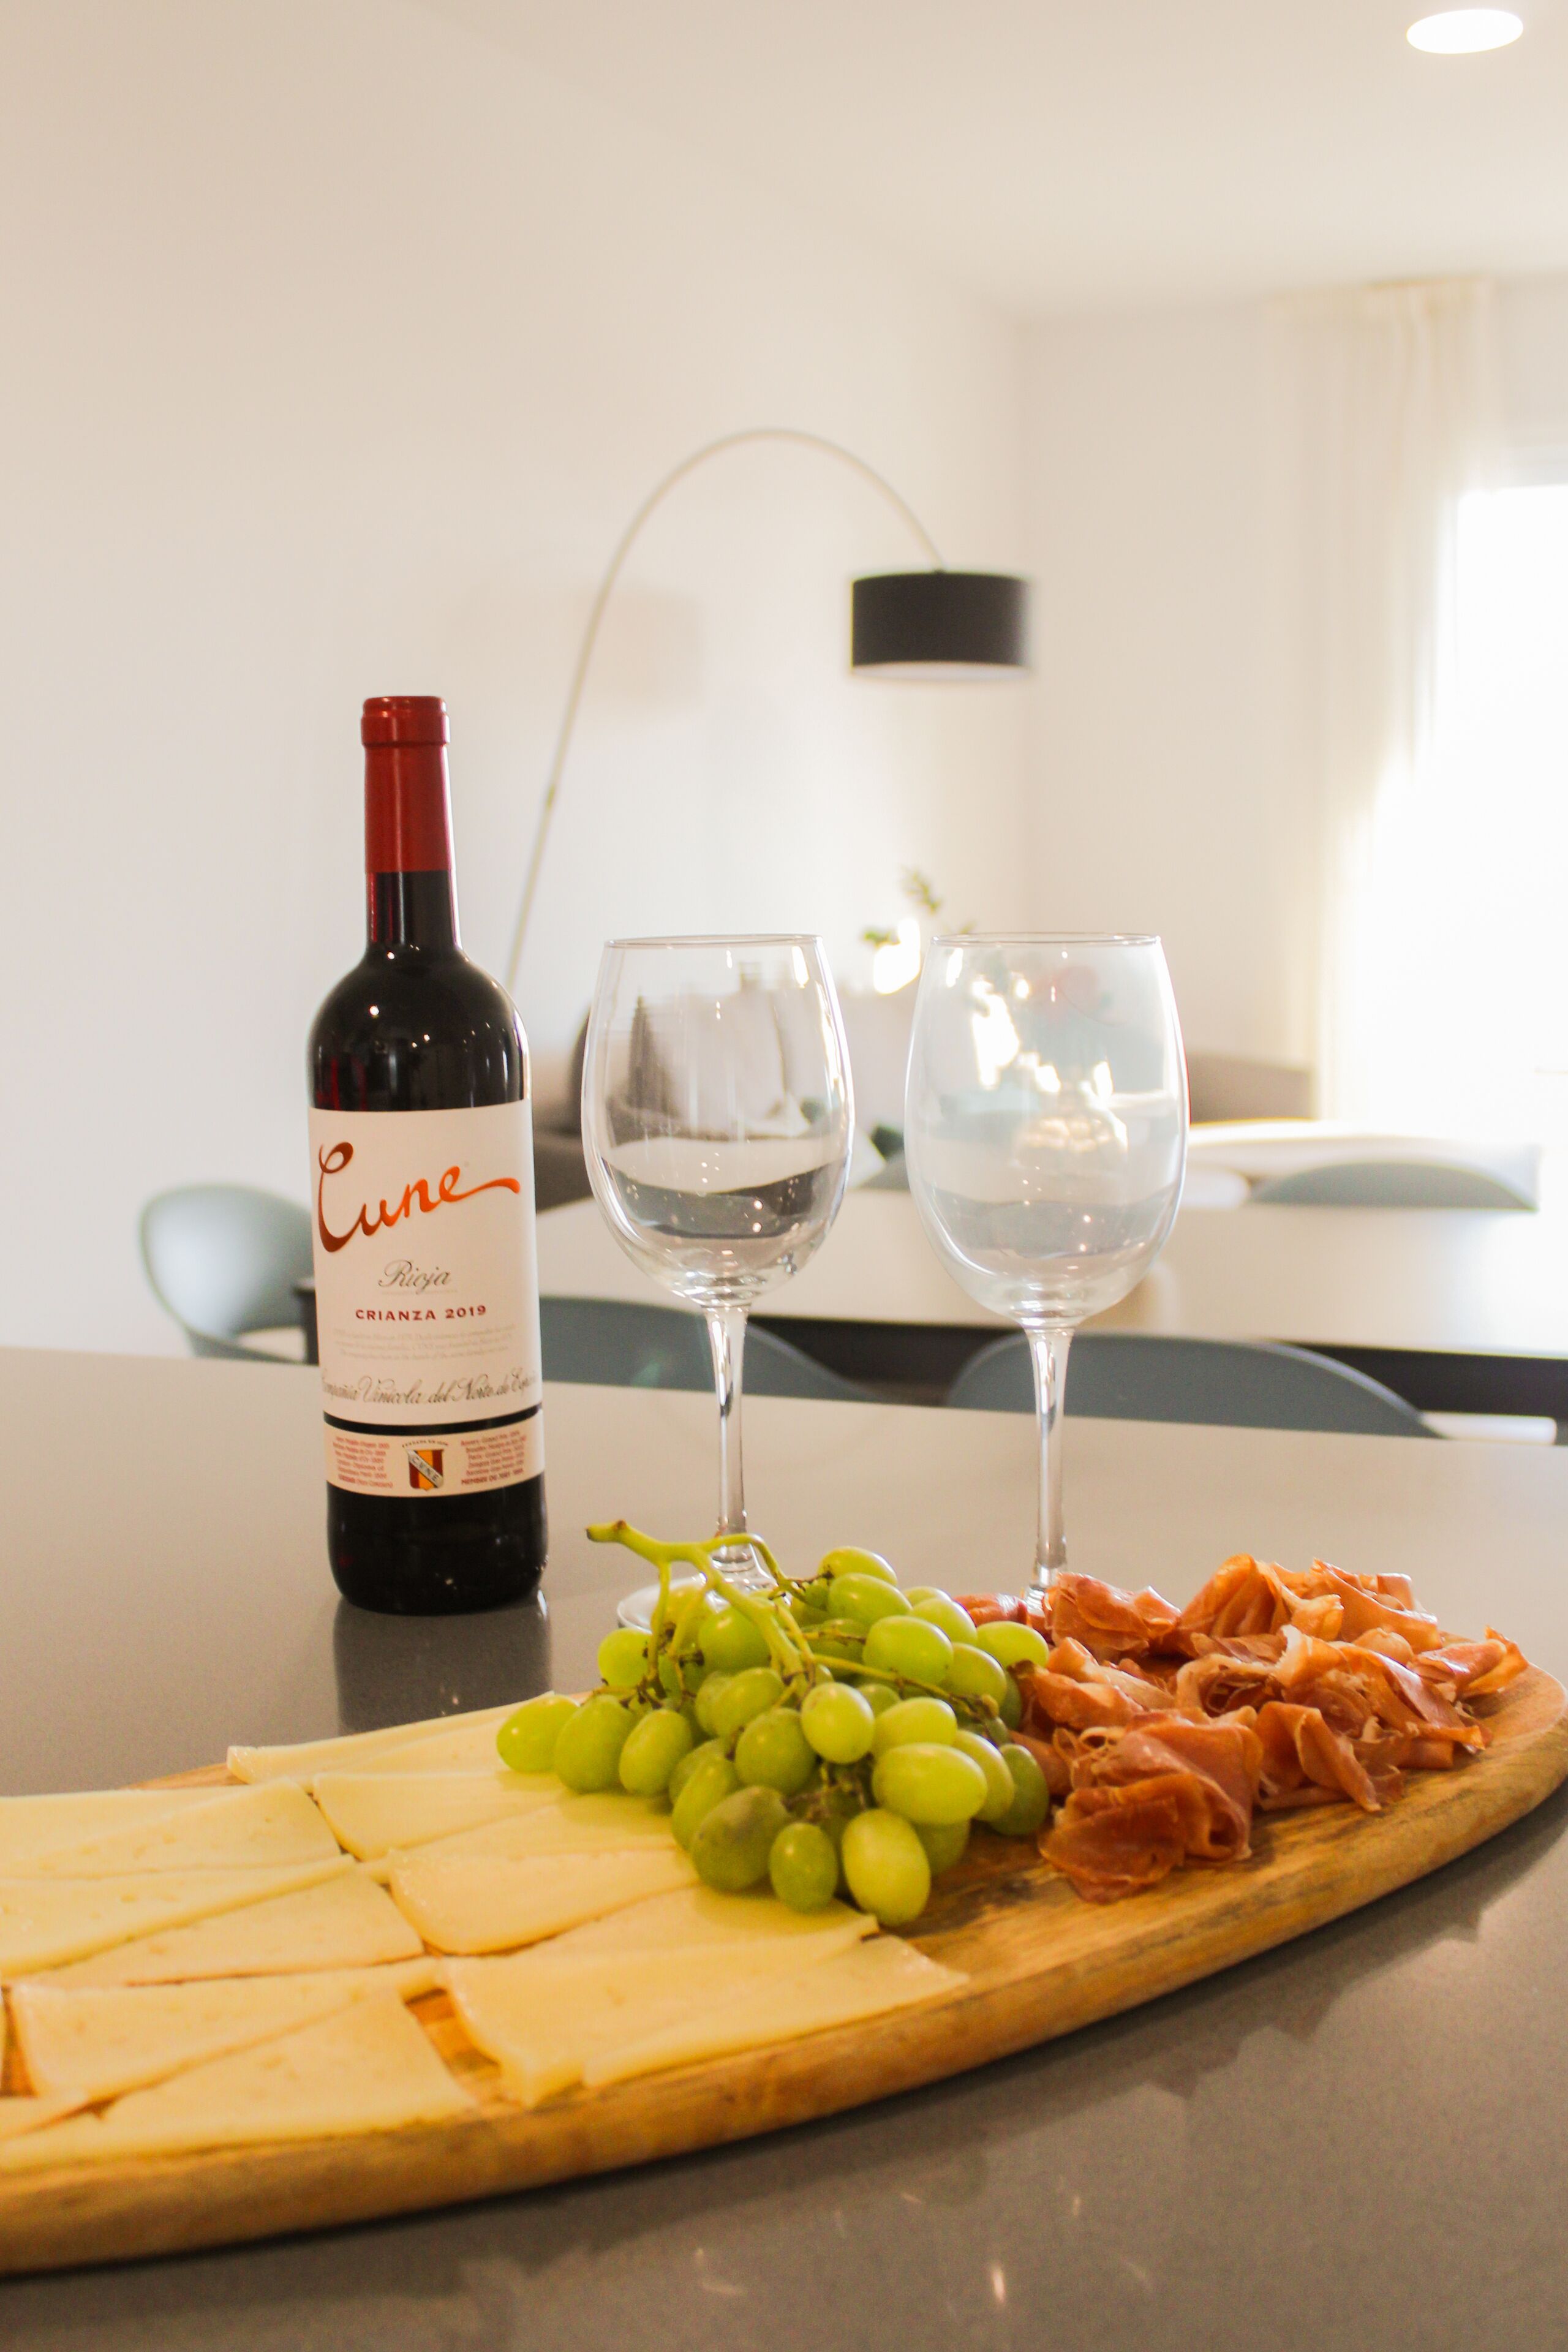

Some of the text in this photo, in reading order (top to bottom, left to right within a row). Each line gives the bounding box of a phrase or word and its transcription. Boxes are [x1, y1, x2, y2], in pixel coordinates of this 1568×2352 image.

[318, 1142, 521, 1253] Cune
[378, 1259, 451, 1295] Rioja
[355, 1305, 486, 1321] CRIANZA 2019
